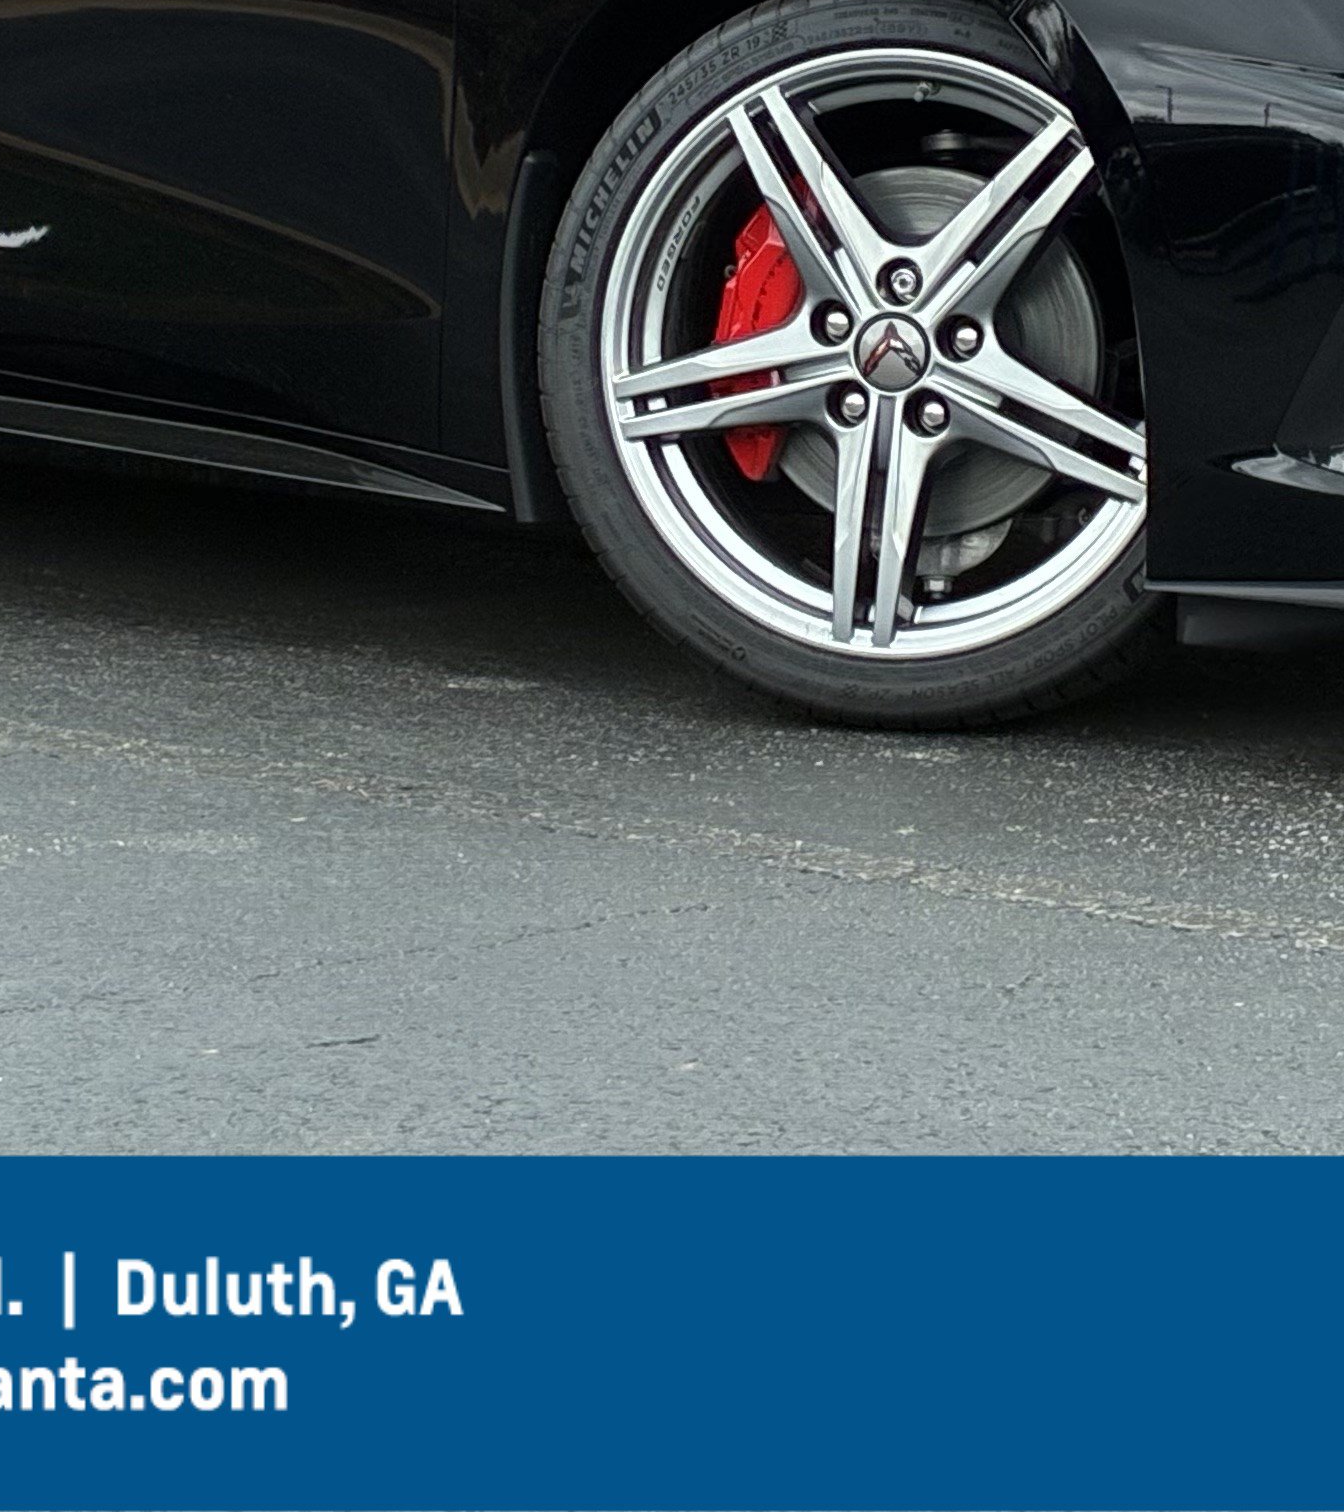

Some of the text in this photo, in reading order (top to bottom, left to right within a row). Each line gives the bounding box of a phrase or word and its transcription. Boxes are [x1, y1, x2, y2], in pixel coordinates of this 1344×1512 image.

[668, 61, 718, 104] 245/35
[721, 46, 741, 67] ZR
[746, 34, 762, 52] 19
[569, 117, 654, 275] MICHELIN
[655, 194, 702, 293] FORGED
[910, 677, 982, 701] SEASON
[1024, 638, 1076, 675] SPORT
